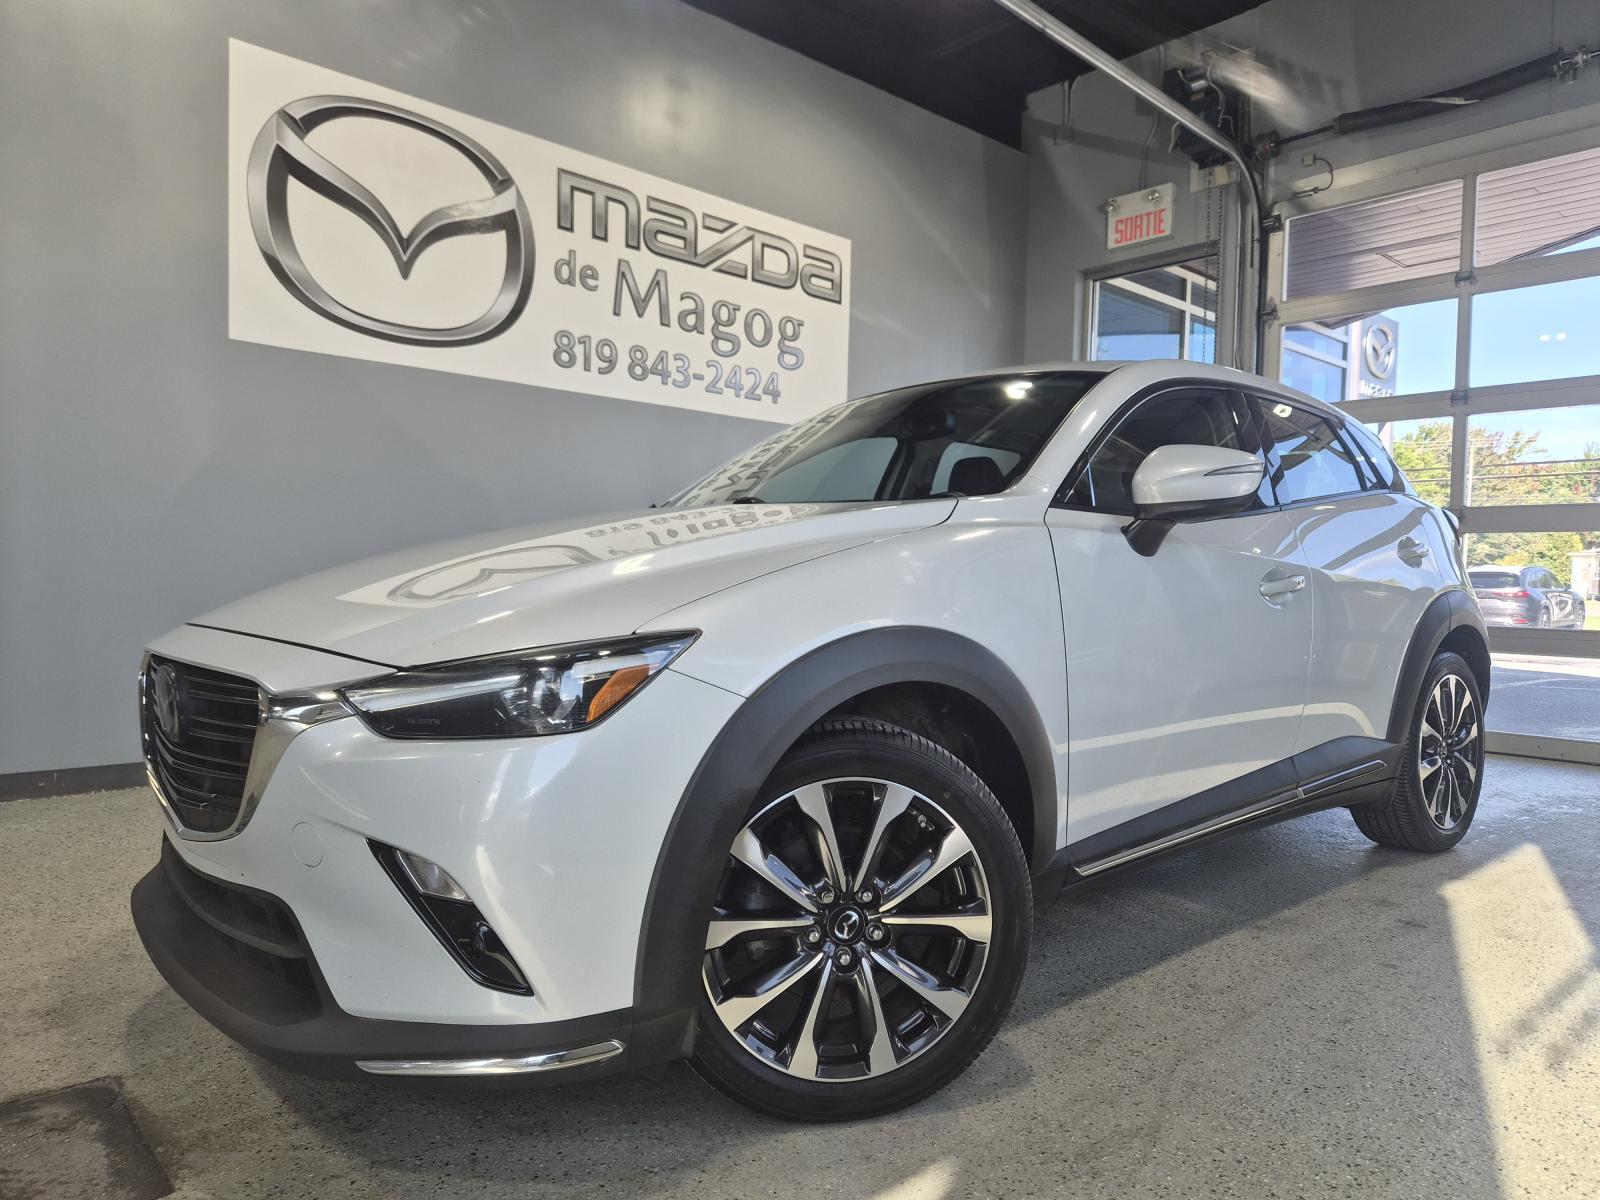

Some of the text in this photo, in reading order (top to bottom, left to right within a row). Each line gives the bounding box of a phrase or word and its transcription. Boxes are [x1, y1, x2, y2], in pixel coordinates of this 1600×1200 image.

[1114, 208, 1167, 246] SORTIE
[554, 250, 805, 370] de Magog
[553, 330, 781, 404] 819 843-2424
